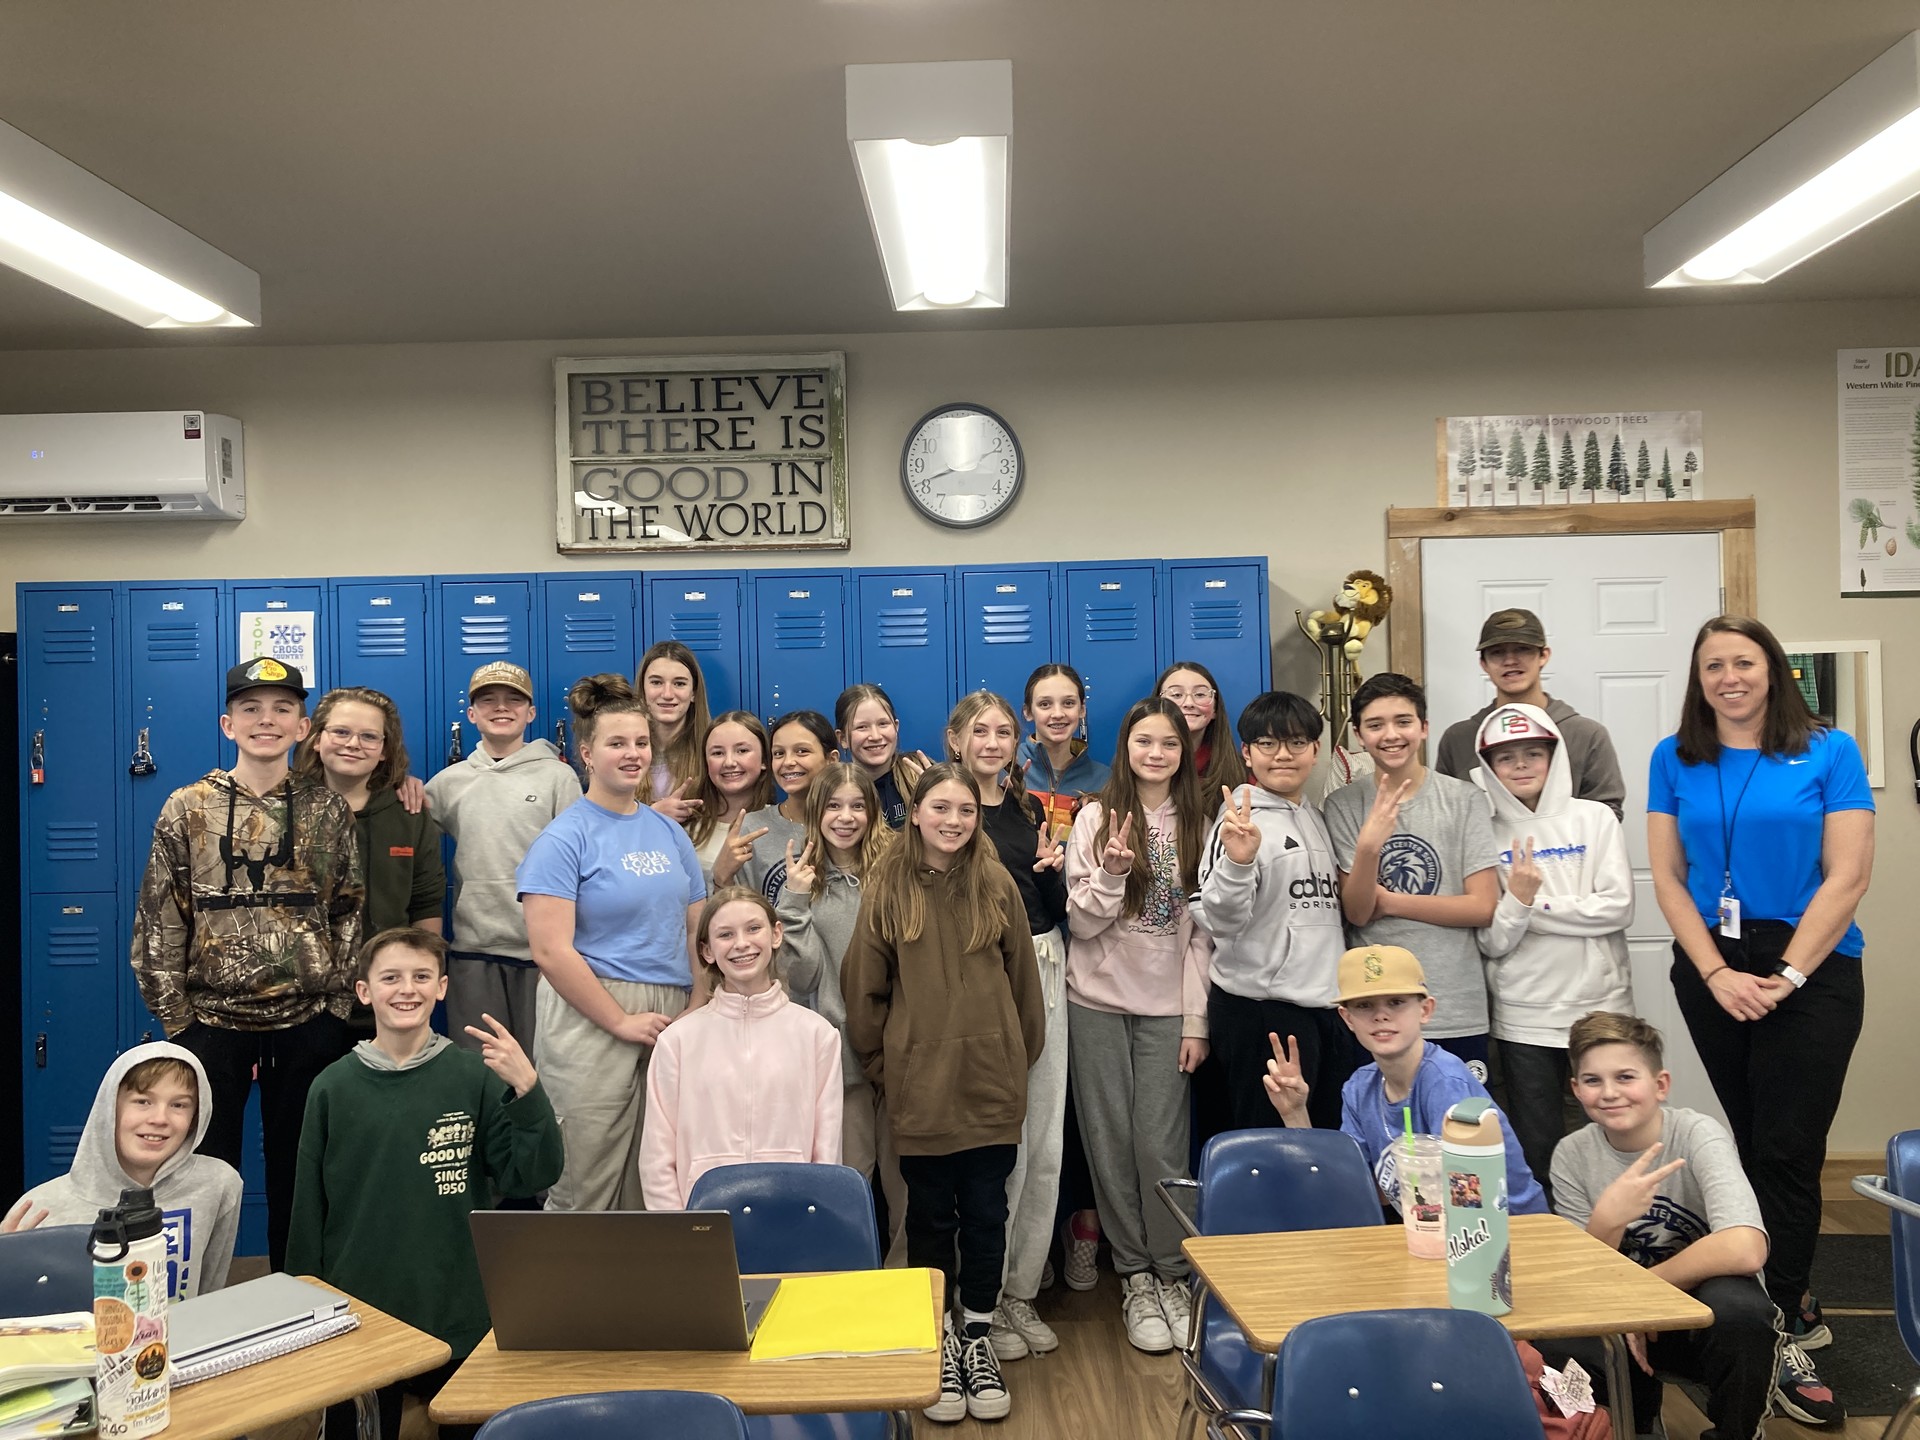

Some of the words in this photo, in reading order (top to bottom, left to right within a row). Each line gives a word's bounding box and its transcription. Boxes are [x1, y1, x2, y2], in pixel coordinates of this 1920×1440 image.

[1846, 381, 1878, 389] Western
[1881, 380, 1903, 389] White
[581, 374, 825, 415] BELIEVE
[1545, 416, 1611, 426] SOFTWOOD
[1615, 415, 1648, 424] TREES
[582, 415, 756, 454] THERE
[780, 413, 826, 450] IS
[921, 438, 937, 454] 10
[992, 437, 1003, 453] 2
[914, 457, 925, 474] 9
[1000, 458, 1010, 475] 3
[582, 466, 749, 502] GOOD
[770, 460, 825, 496] IN
[920, 478, 931, 495] 8
[991, 479, 1002, 495] 4
[936, 493, 946, 509] 7
[581, 505, 660, 540] THE
[674, 501, 827, 541] WORLD
[272, 645, 304, 654] CROSS
[1392, 841, 1423, 853] CENTER
[1499, 843, 1586, 864] Campion
[768, 869, 786, 905] RISTIA
[419, 1149, 455, 1165] GOOD
[434, 1167, 468, 1184] SINCE
[437, 1181, 466, 1196] 1950
[1448, 1219, 1490, 1262] Aloha!
